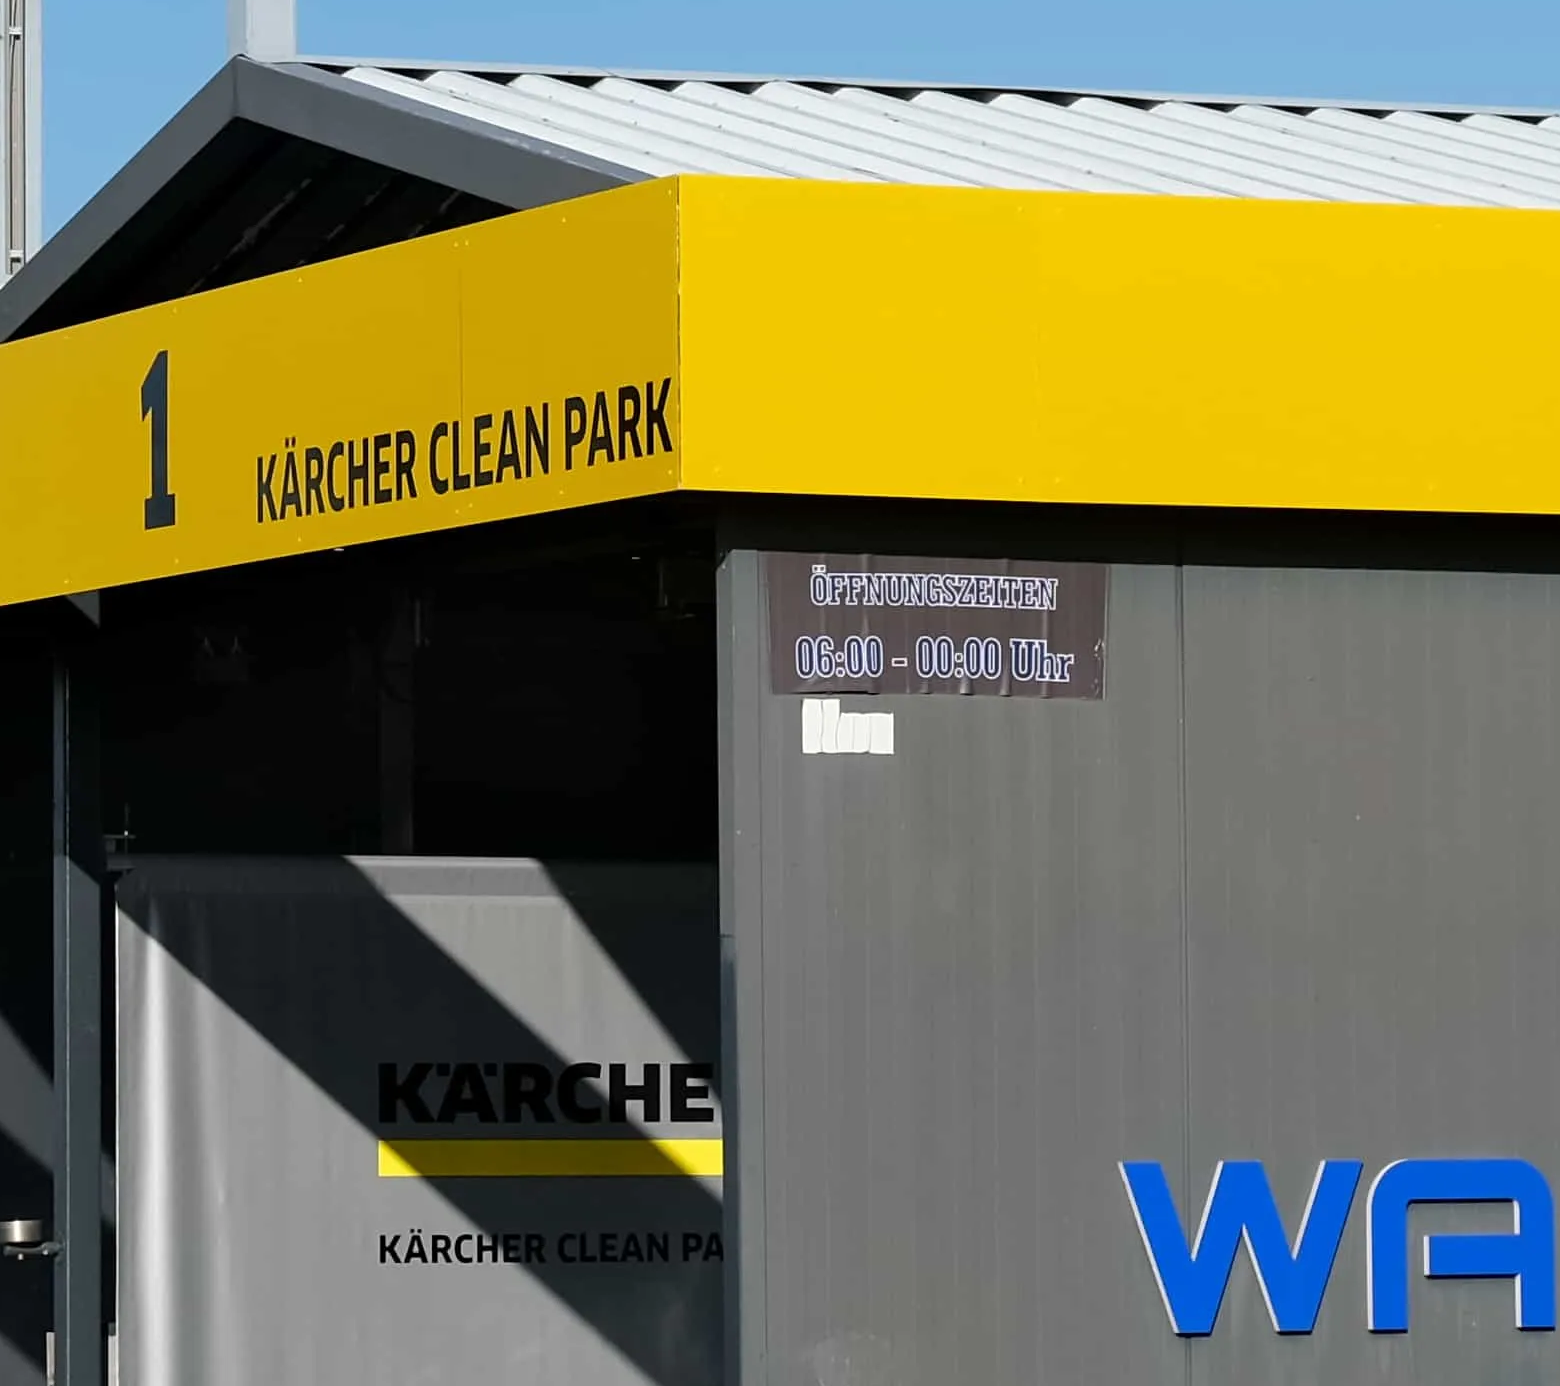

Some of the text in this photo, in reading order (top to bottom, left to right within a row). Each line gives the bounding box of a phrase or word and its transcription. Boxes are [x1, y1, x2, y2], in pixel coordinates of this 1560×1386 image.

[140, 350, 176, 530] 1
[257, 377, 673, 524] KÄRCHER CLEAN PARK
[810, 564, 1058, 611] ÖFFNUNGSZEITEN
[795, 635, 883, 679] 06:00
[915, 636, 1002, 679] 00:00
[1010, 638, 1075, 683] Uhr
[378, 1062, 715, 1124] KÄRCHE
[378, 1228, 723, 1264] KÄRCHER CLEAN PA
